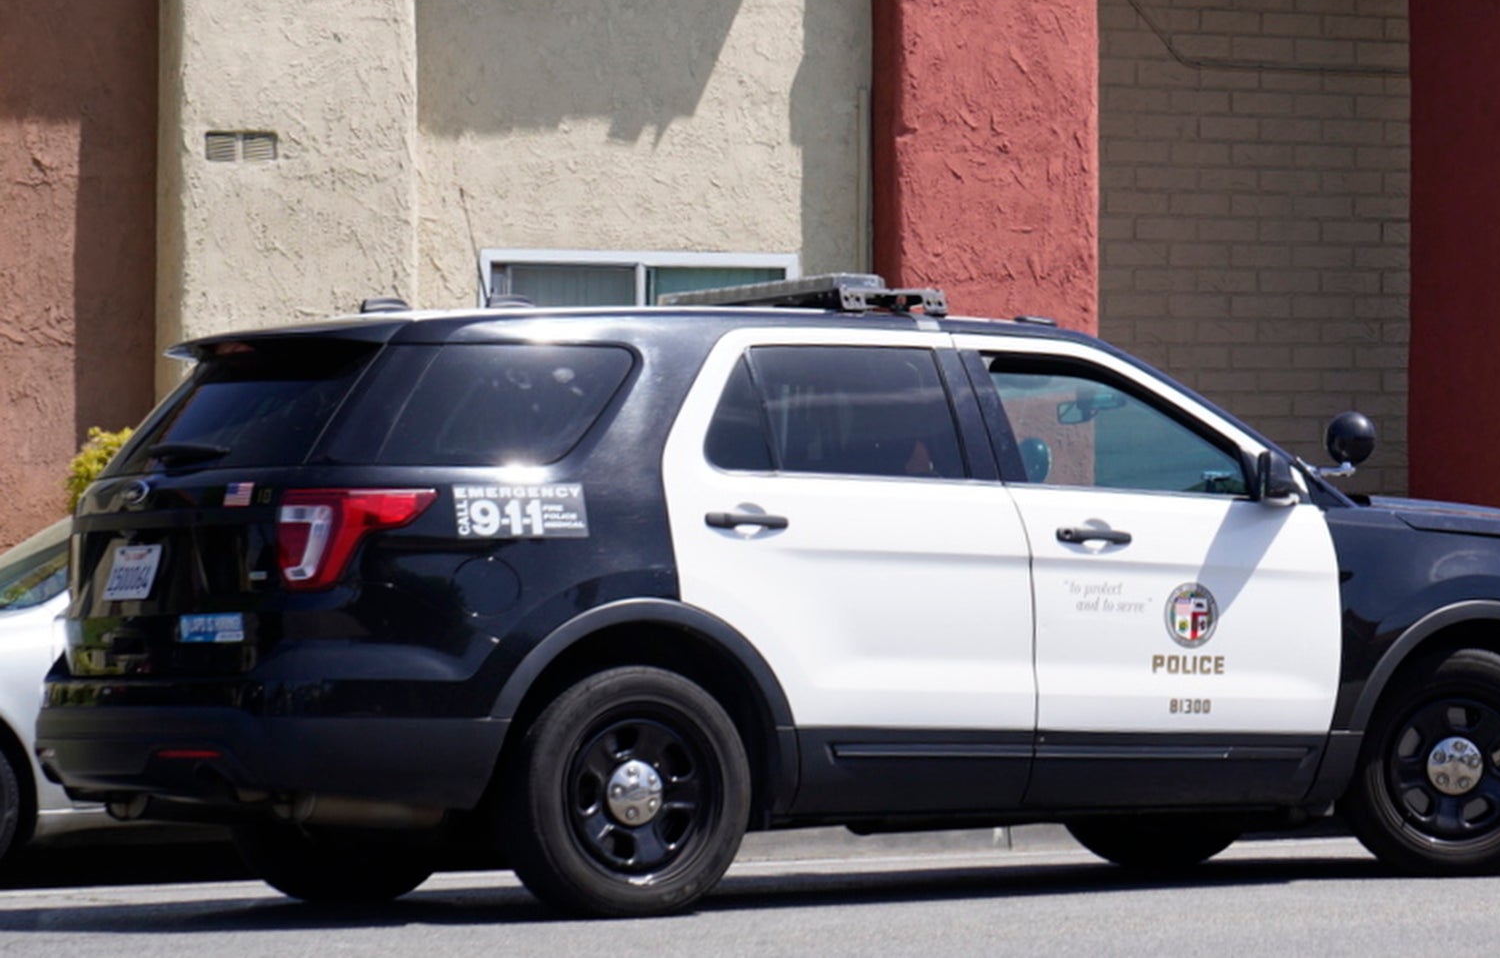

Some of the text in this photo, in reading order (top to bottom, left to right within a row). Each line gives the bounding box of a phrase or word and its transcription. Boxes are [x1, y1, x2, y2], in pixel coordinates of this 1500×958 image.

[453, 487, 580, 498] EMERGENCY
[456, 500, 470, 535] CALL
[1084, 582, 1123, 596] protect
[1076, 599, 1098, 612] and
[1102, 598, 1115, 612] to
[1152, 654, 1225, 675] POLICE
[1169, 699, 1211, 714] 81300
